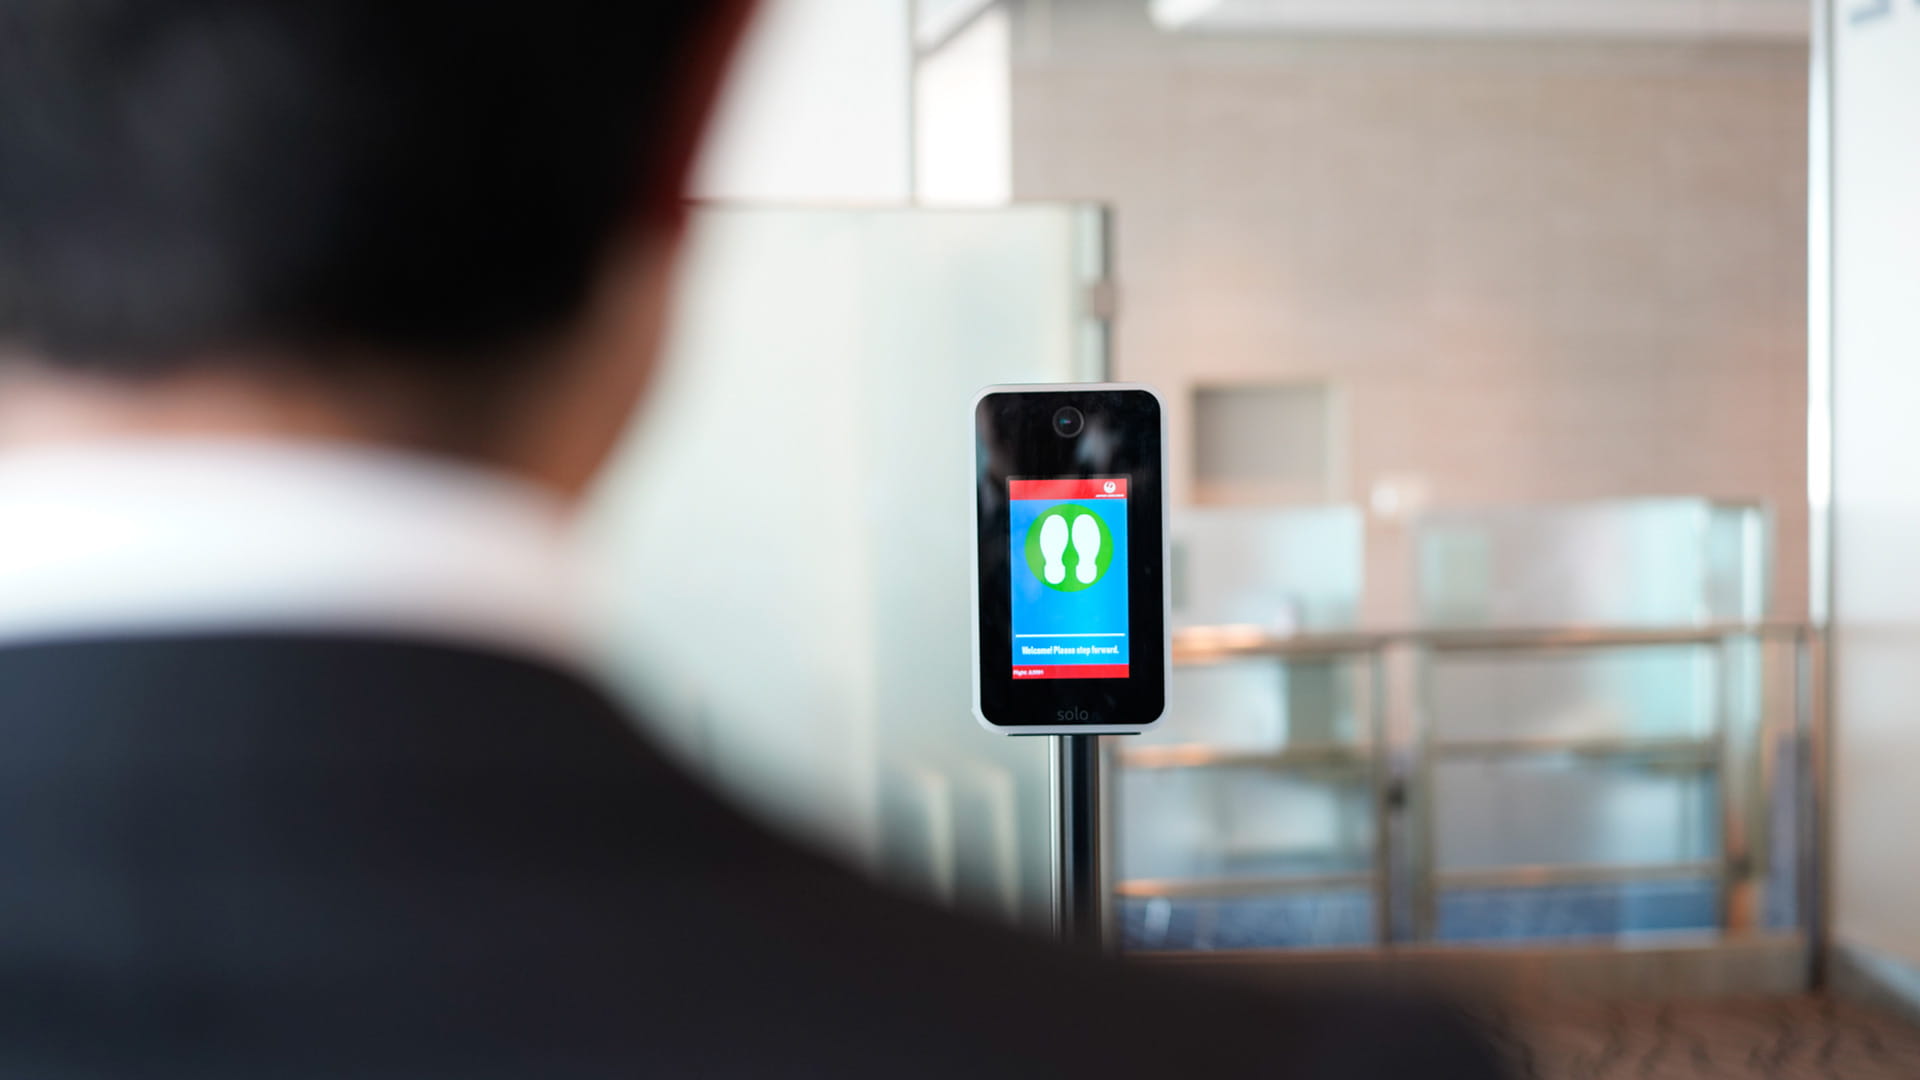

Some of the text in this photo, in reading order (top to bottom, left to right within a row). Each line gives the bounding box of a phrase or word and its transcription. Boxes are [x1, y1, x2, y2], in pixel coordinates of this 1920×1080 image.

[1021, 644, 1120, 656] Welcome! Please step forward.
[1057, 705, 1089, 721] solo
